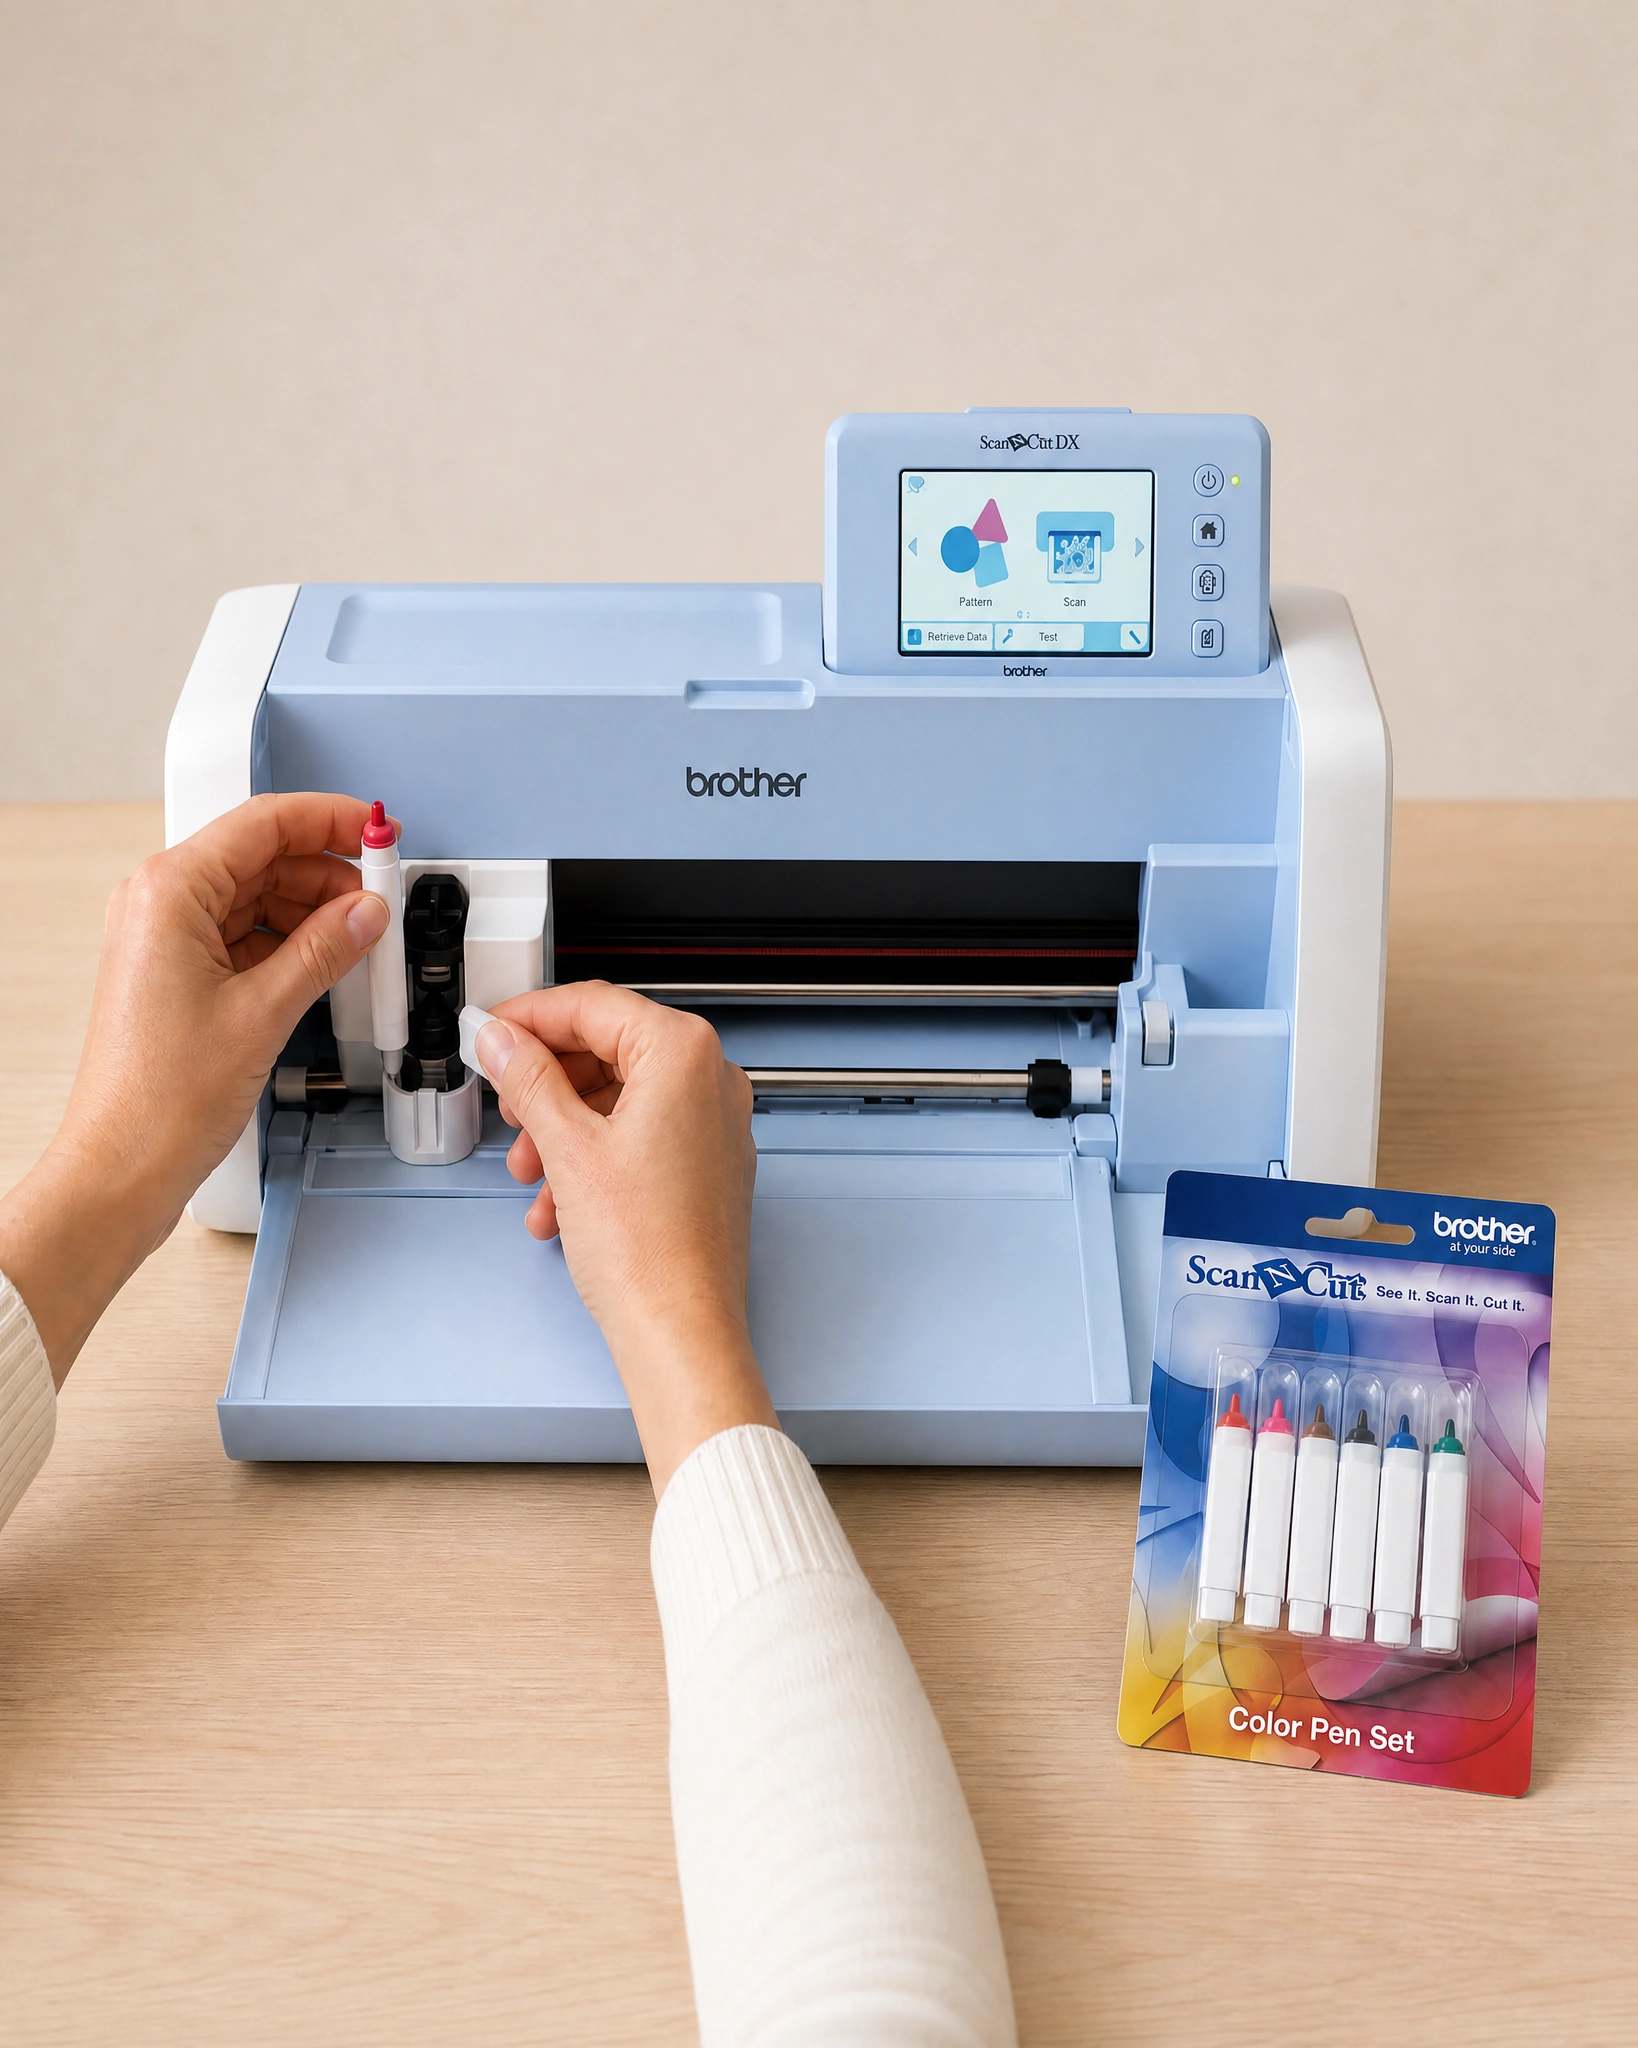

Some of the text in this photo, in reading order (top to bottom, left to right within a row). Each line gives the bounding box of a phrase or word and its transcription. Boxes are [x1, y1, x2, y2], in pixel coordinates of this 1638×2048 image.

[1055, 434, 1080, 450] DX
[959, 597, 993, 607] Pattern
[1063, 597, 1086, 607] Scan
[928, 632, 988, 642] Retrieve Data
[1039, 632, 1058, 642] Test
[1003, 665, 1047, 677] brother
[686, 766, 807, 797] brother
[1433, 1211, 1535, 1245] brother
[1450, 1242, 1516, 1257] at your side
[1376, 1285, 1525, 1312] See It. Scan It. Cut It.
[1229, 1706, 1414, 1754] Color Pen Set
